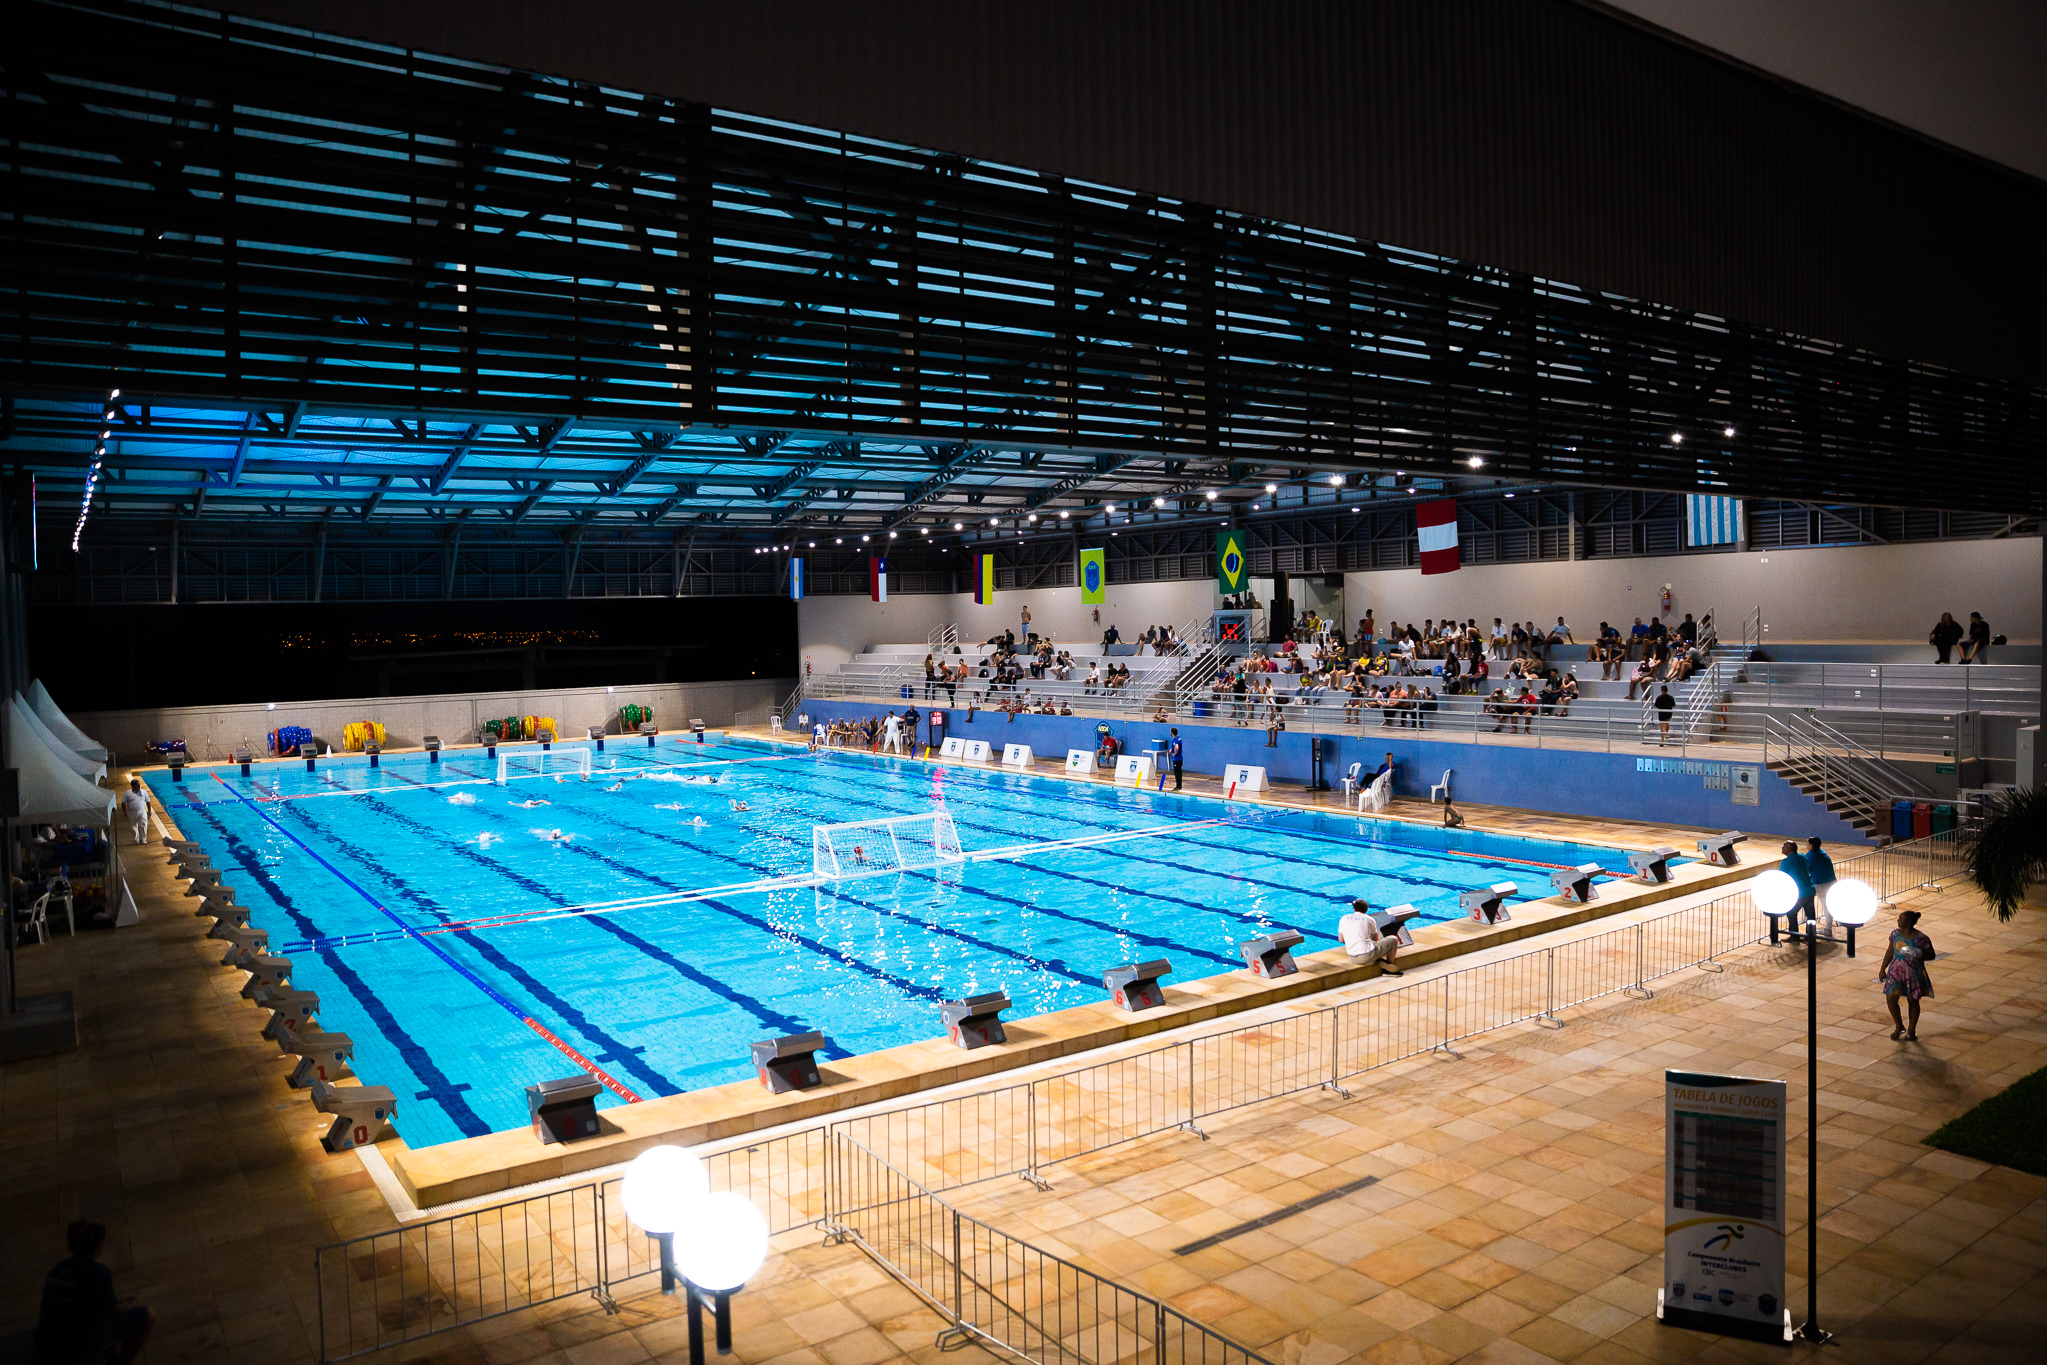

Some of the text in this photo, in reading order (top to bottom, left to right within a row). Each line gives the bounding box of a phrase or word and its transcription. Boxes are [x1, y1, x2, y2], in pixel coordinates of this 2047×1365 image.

[1710, 852, 1718, 862] 0
[1642, 868, 1648, 879] 1
[1564, 887, 1571, 898] 2
[1473, 907, 1481, 921] 3
[1253, 960, 1260, 975] 5
[1276, 961, 1286, 974] 5
[1115, 991, 1123, 1006] 6
[1140, 992, 1151, 1006] 6
[951, 1026, 959, 1043] 7
[978, 1028, 988, 1044] 7
[316, 1065, 329, 1081] 1
[789, 1069, 803, 1087] 8
[1673, 1088, 1779, 1109] TABELA DE JOGOS
[562, 1116, 577, 1136] 9
[354, 1125, 368, 1144] 0
